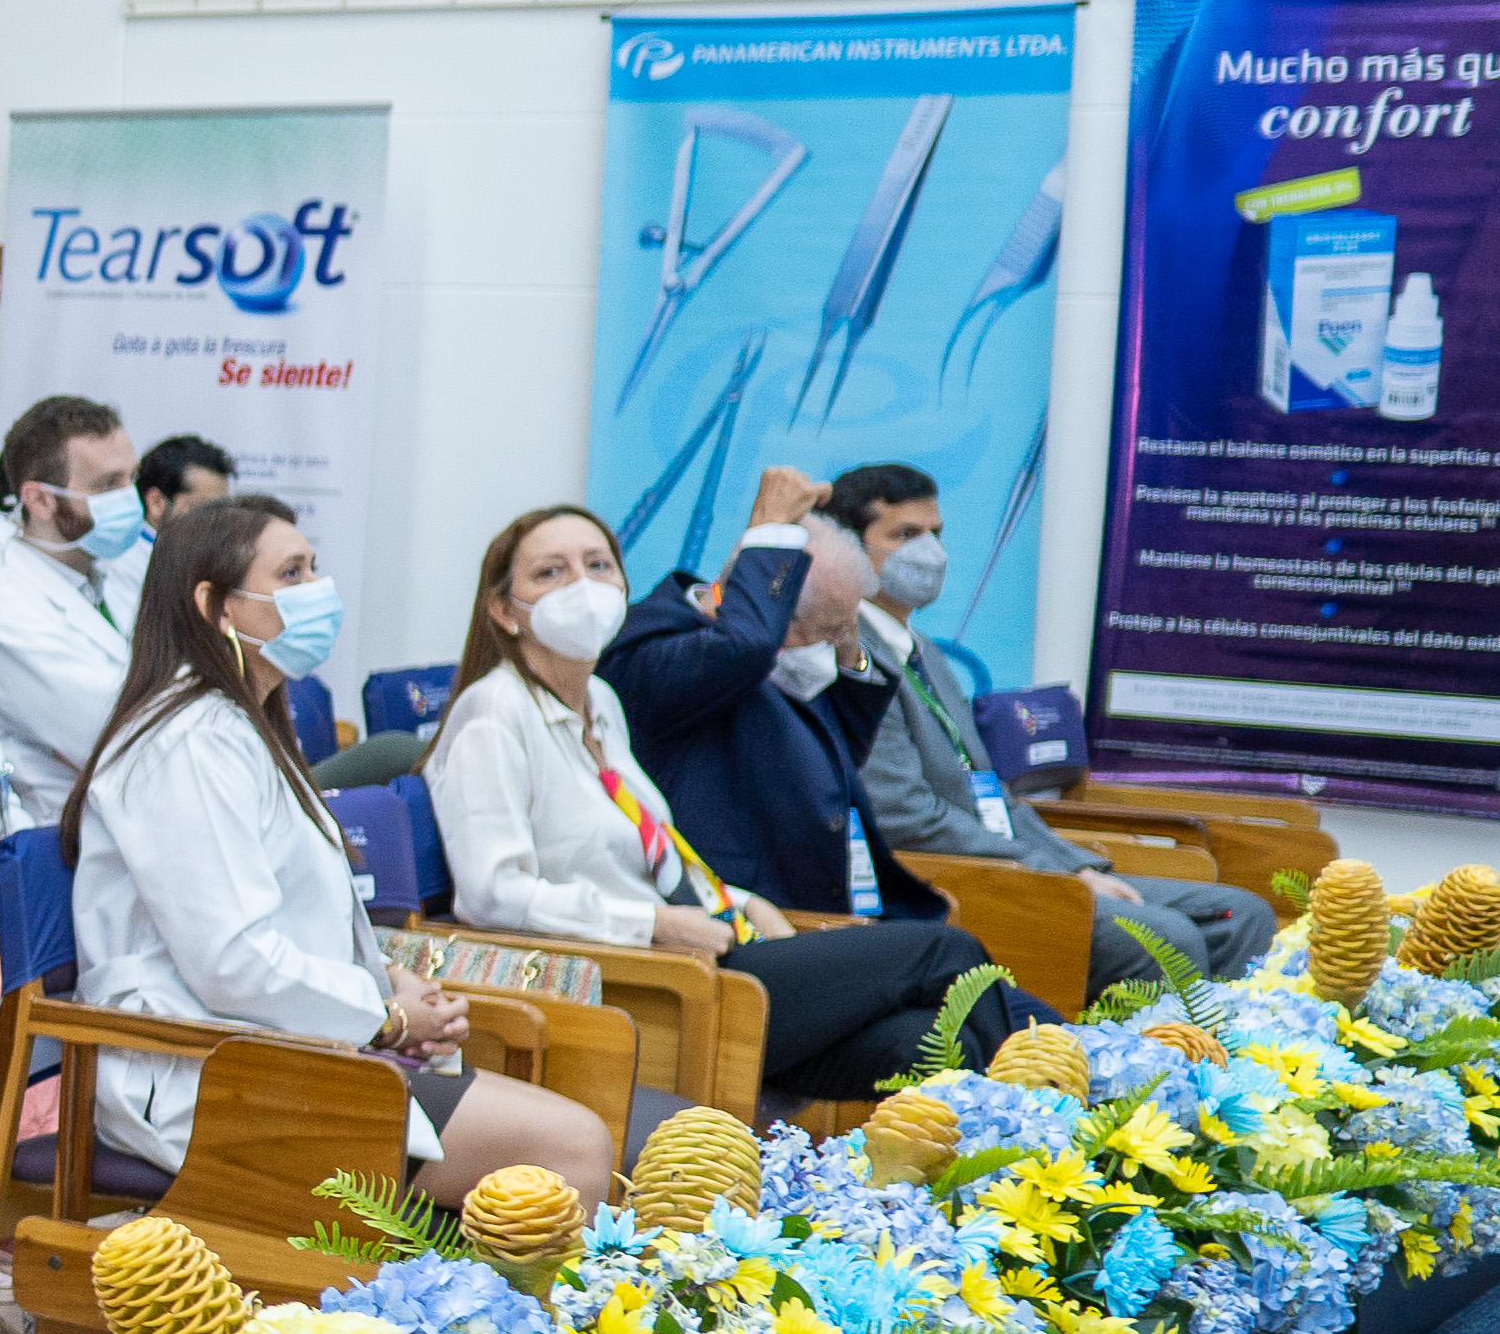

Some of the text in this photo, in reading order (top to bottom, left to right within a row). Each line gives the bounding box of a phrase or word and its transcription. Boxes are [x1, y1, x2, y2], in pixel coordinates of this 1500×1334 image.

[691, 39, 841, 65] PANAMERICAN
[846, 35, 1002, 61] INSTRUMENTS
[1217, 48, 1348, 84] Mucho
[1359, 46, 1446, 82] más
[1260, 86, 1475, 155] confort
[31, 198, 353, 288] Tearsoft
[218, 356, 354, 389] Se siente!
